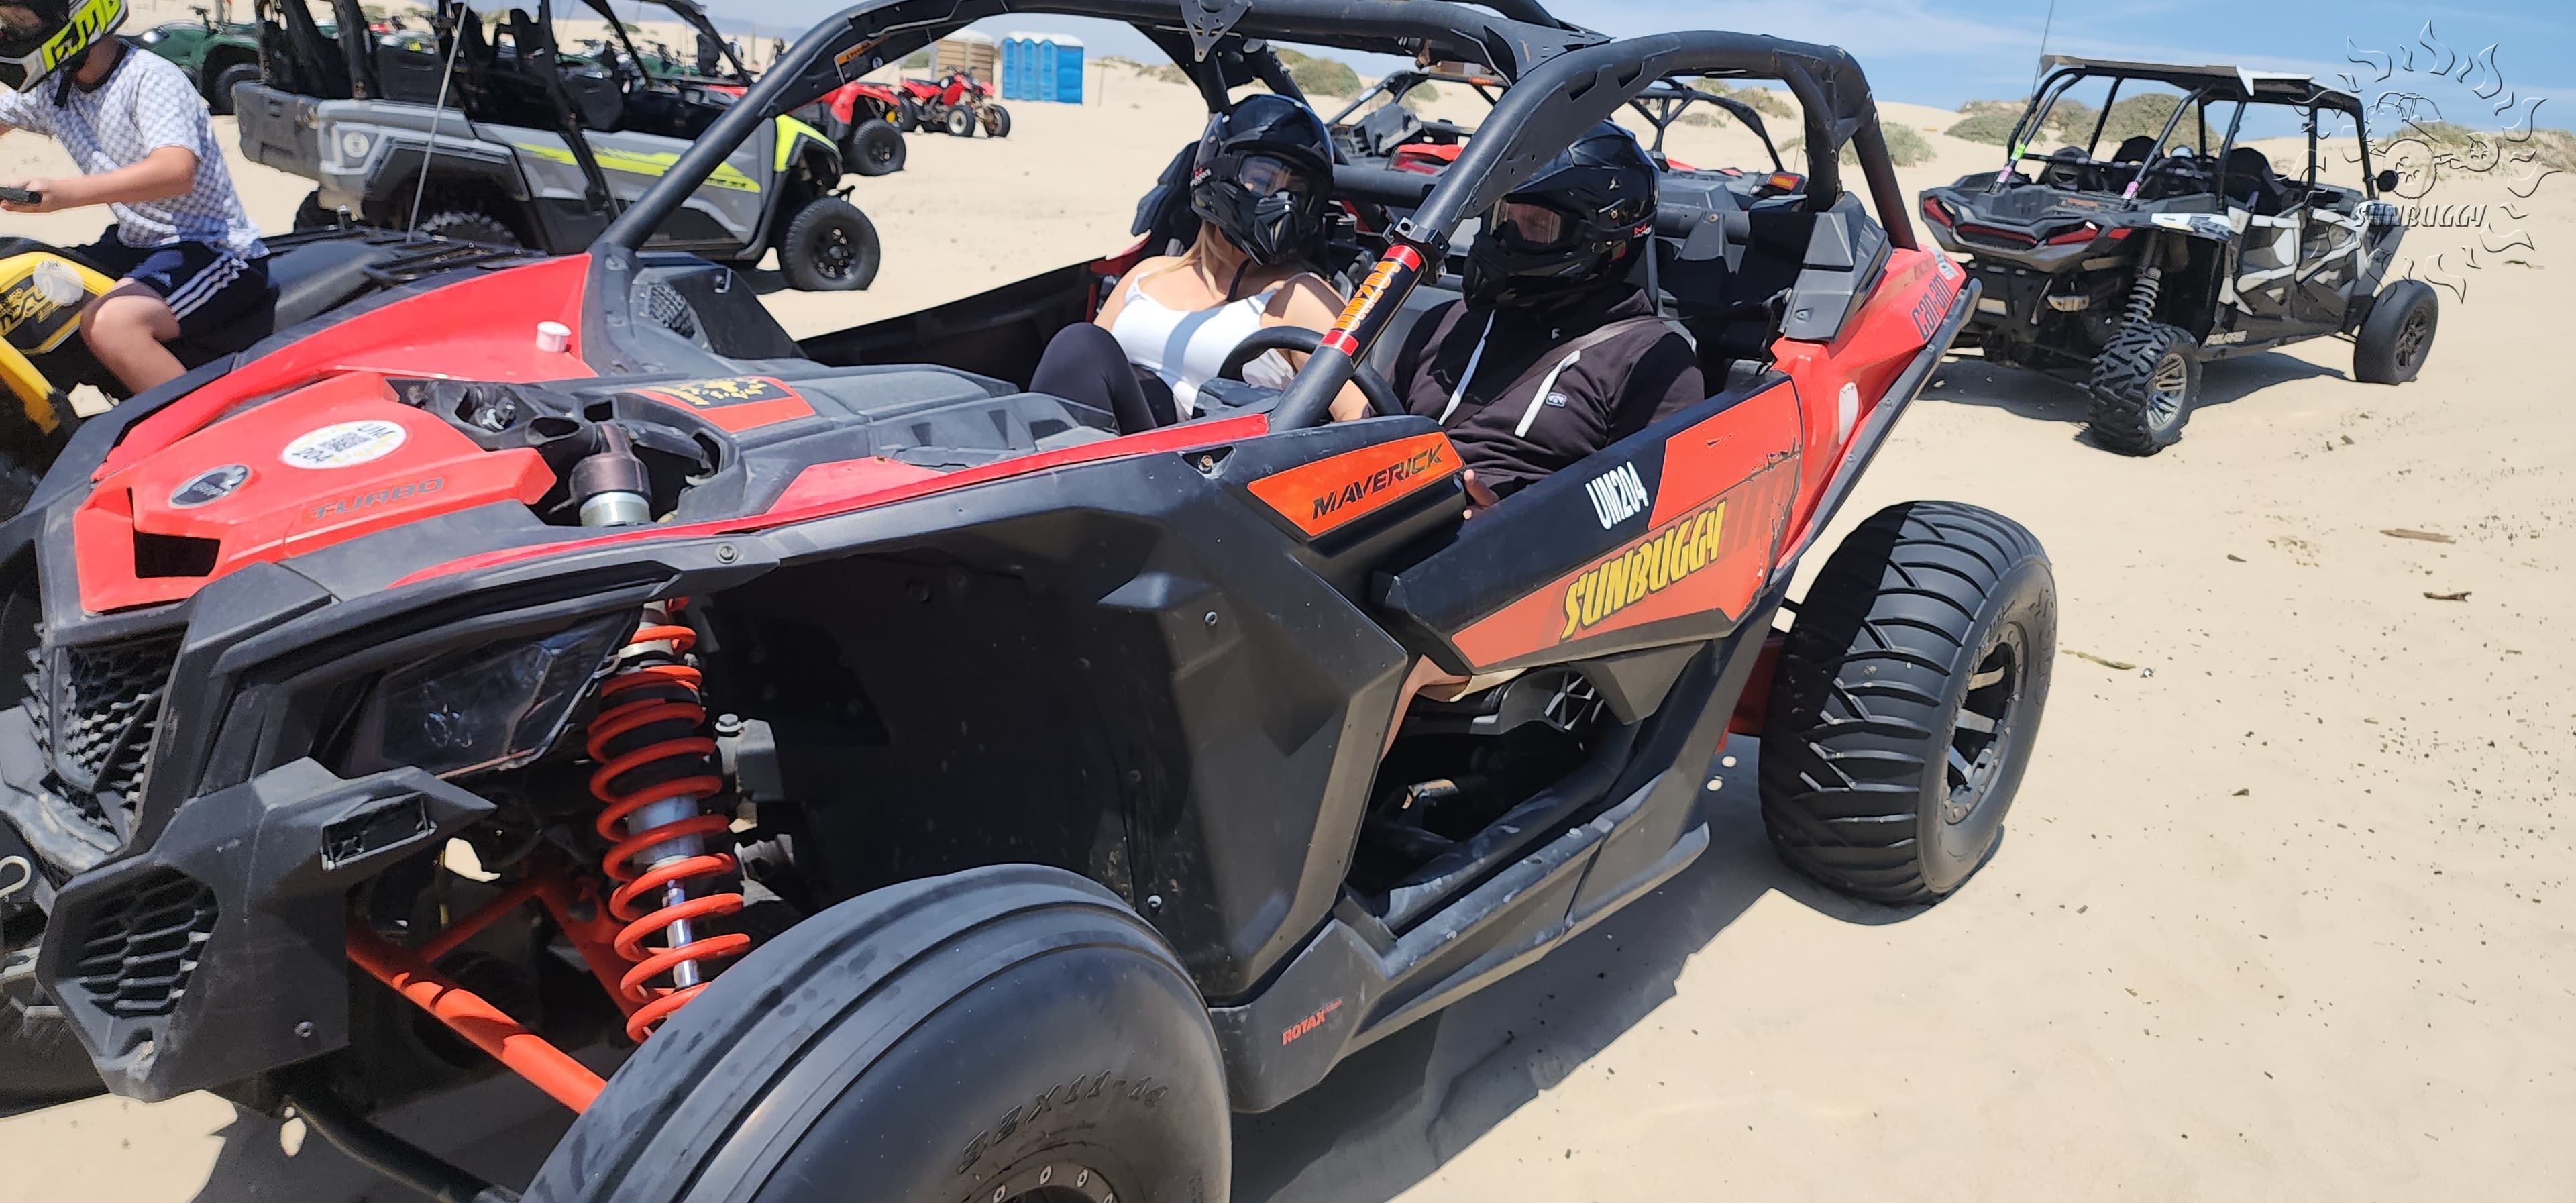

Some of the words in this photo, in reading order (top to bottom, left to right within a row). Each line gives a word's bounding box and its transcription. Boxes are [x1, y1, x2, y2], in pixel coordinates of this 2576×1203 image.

[1334, 261, 1402, 332] UM204
[1912, 271, 1953, 342] can-am
[2204, 331, 2247, 346] POLARIS
[311, 478, 444, 519] TURBO
[1312, 442, 1444, 521] MAVERICK
[1584, 460, 1650, 530] UM204
[1559, 498, 1727, 641] SUNBUGGY
[1281, 1008, 1326, 1046] ROTAX
